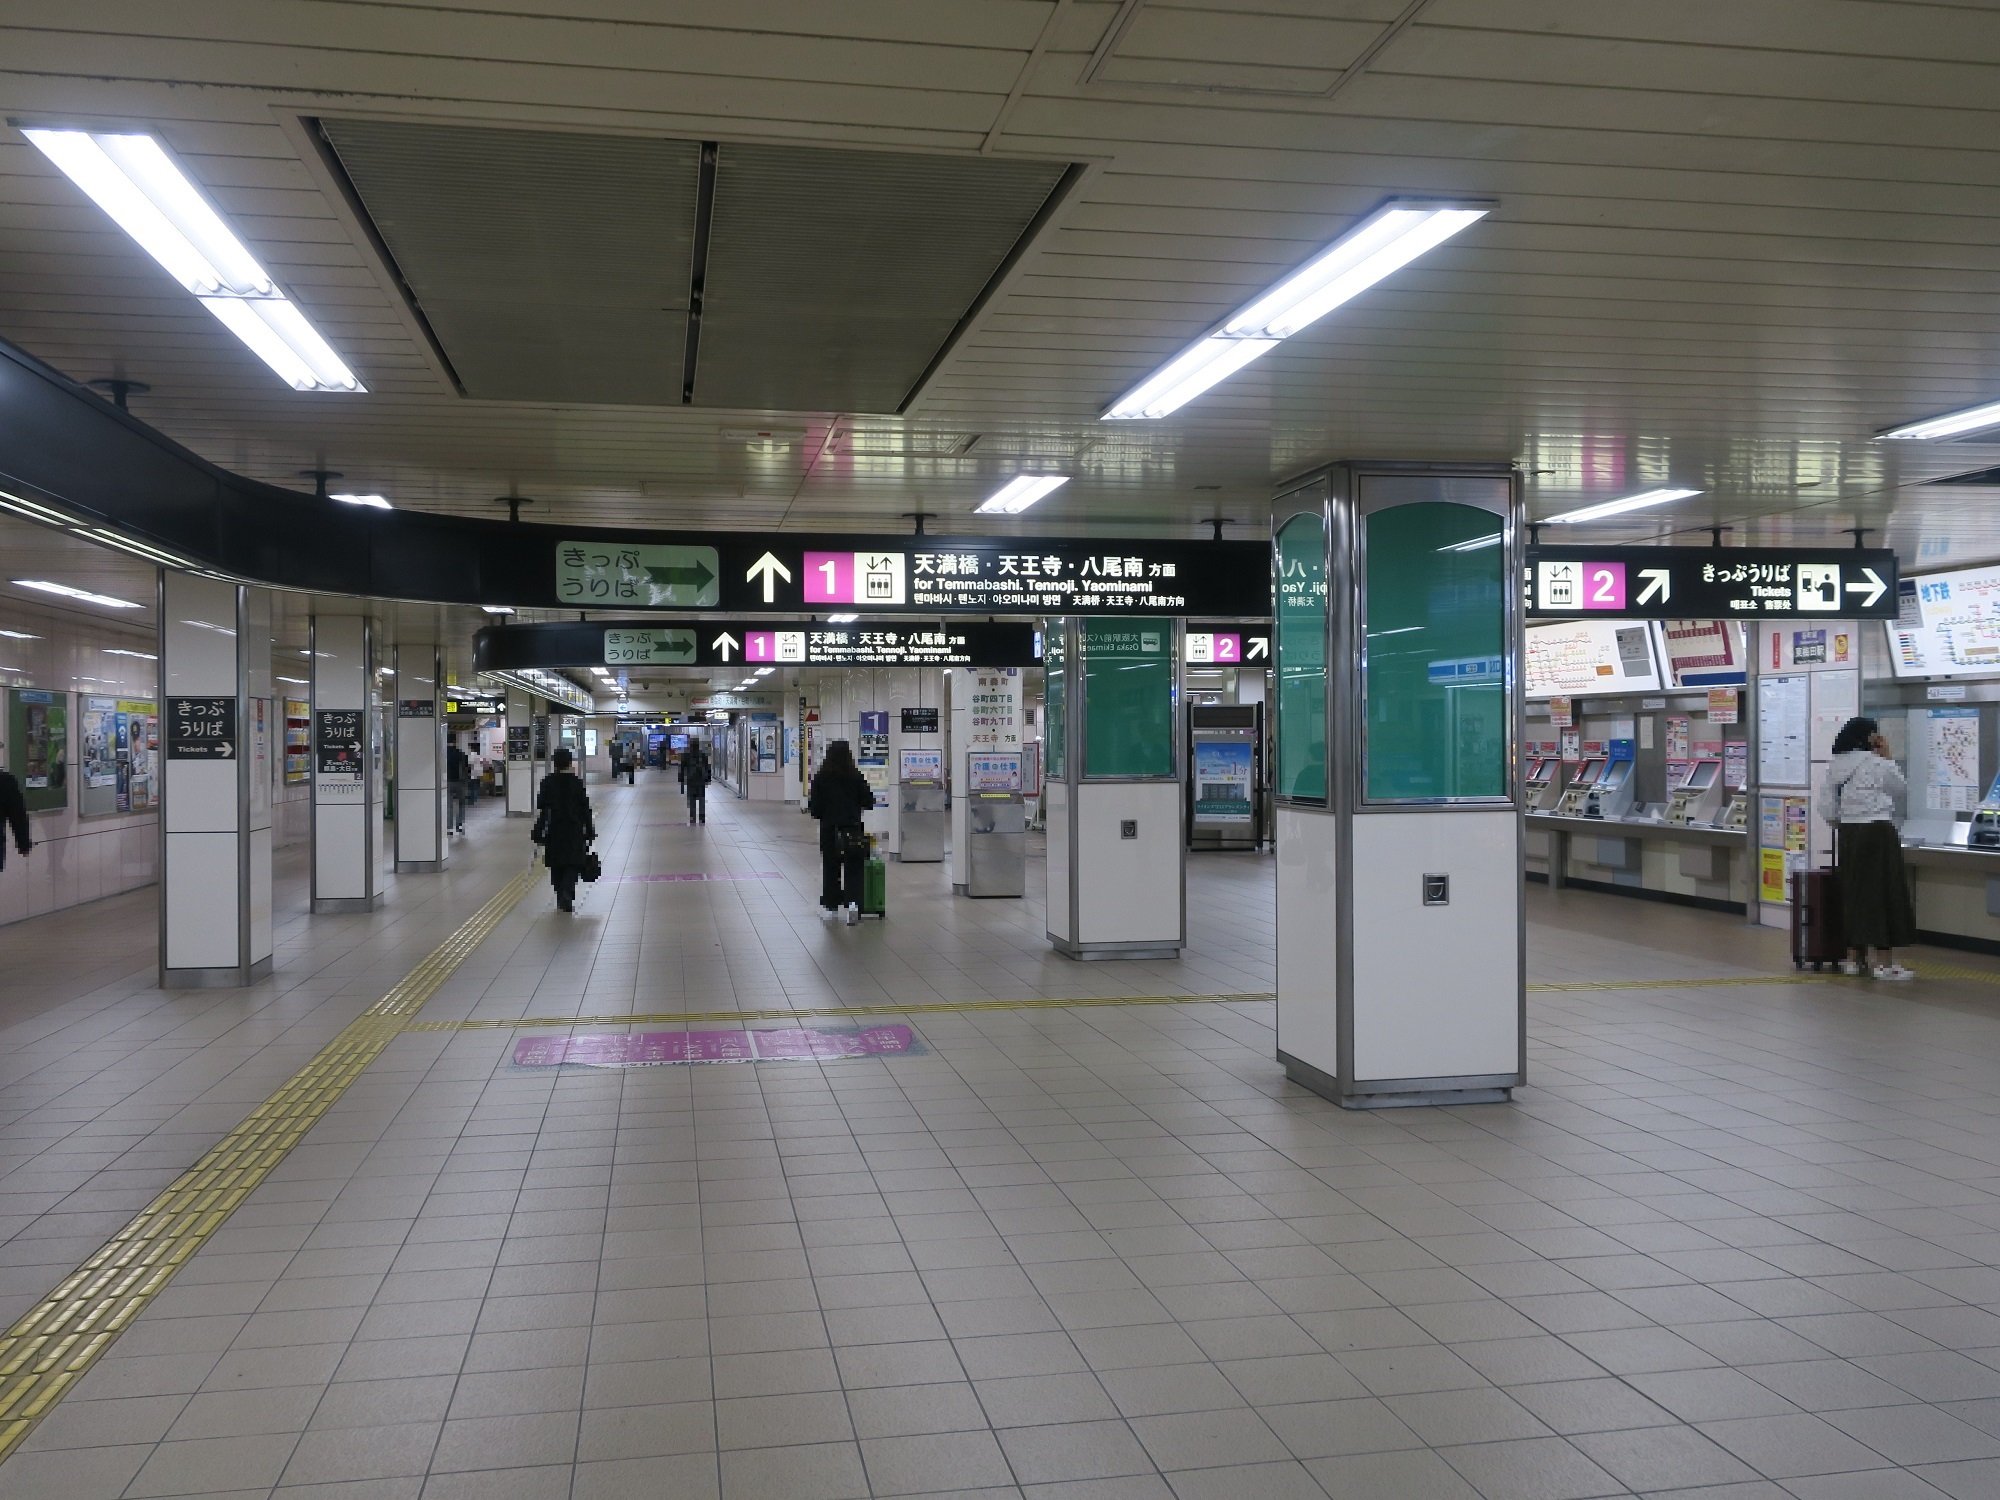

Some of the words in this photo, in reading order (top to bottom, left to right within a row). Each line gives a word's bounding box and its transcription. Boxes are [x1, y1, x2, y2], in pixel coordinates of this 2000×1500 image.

[563, 548, 640, 569] きっぷ
[1148, 563, 1176, 577] 方面
[1702, 563, 1792, 582] きっぷうりば
[818, 560, 836, 595] 1
[913, 578, 933, 590] for
[1081, 580, 1153, 592] Yaominami
[1592, 569, 1616, 602] 2
[1750, 586, 1792, 597] Tickets
[1042, 594, 1061, 606] 방면
[1730, 600, 1758, 610] 매표소
[608, 632, 651, 644] きっぷ
[949, 636, 966, 645] 方面
[754, 636, 765, 657] 1
[909, 646, 952, 654] Yaominami
[1218, 637, 1235, 658] 2
[608, 649, 651, 660] うりば
[972, 694, 1012, 703] 谷町四丁目
[178, 701, 225, 716] きっぷ
[972, 706, 1012, 714] 谷町六丁目
[323, 713, 356, 724] きっぷ
[867, 713, 880, 731] 1
[972, 717, 1012, 726] 谷町九丁目
[180, 721, 223, 736] うりば
[325, 726, 356, 738] うりば
[973, 735, 998, 743] 天王寺
[974, 762, 1018, 771] 介護の仕事
